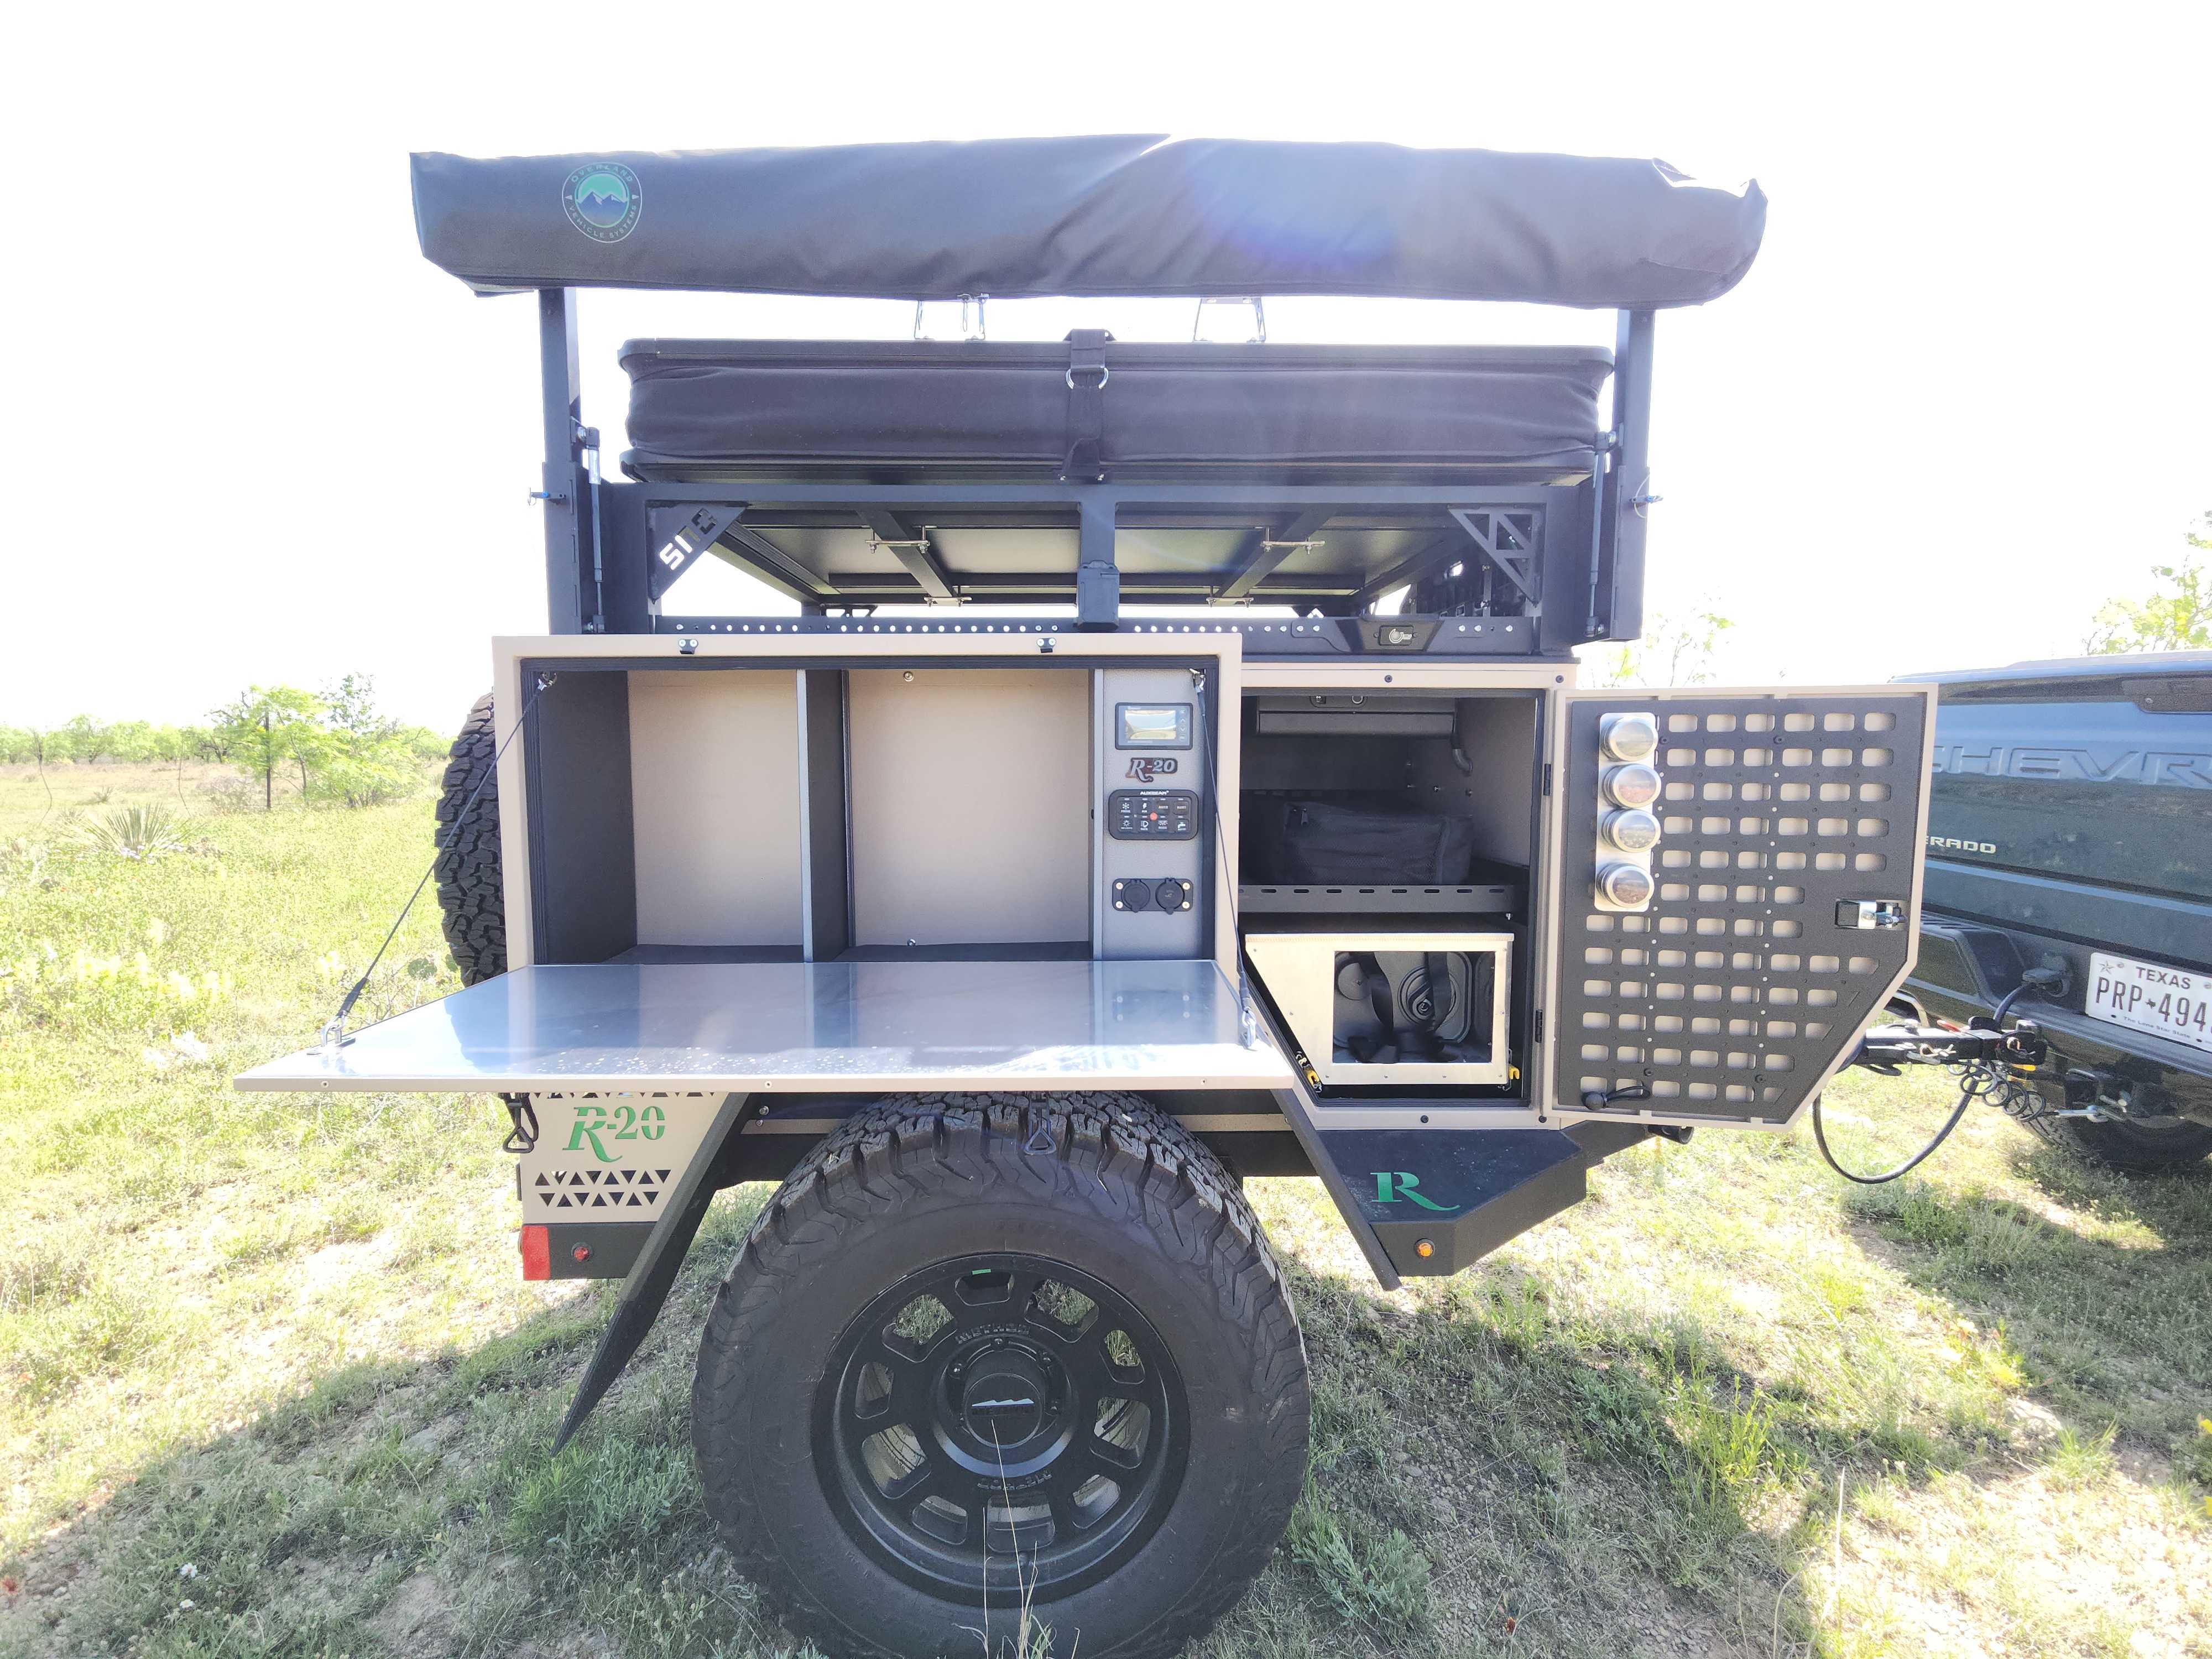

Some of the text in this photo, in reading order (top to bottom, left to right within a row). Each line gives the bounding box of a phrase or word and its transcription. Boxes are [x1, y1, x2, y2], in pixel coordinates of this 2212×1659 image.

[571, 165, 633, 183] OVERLAND
[570, 205, 637, 238] VEHICLE SYSTEMS
[1125, 758, 1177, 782] R-20
[1932, 745, 2212, 790] HEVR
[2136, 966, 2191, 989] TEXAS
[2096, 977, 2212, 1032] PRP 494
[562, 1105, 666, 1163] R-20
[1370, 1172, 1460, 1211] R
